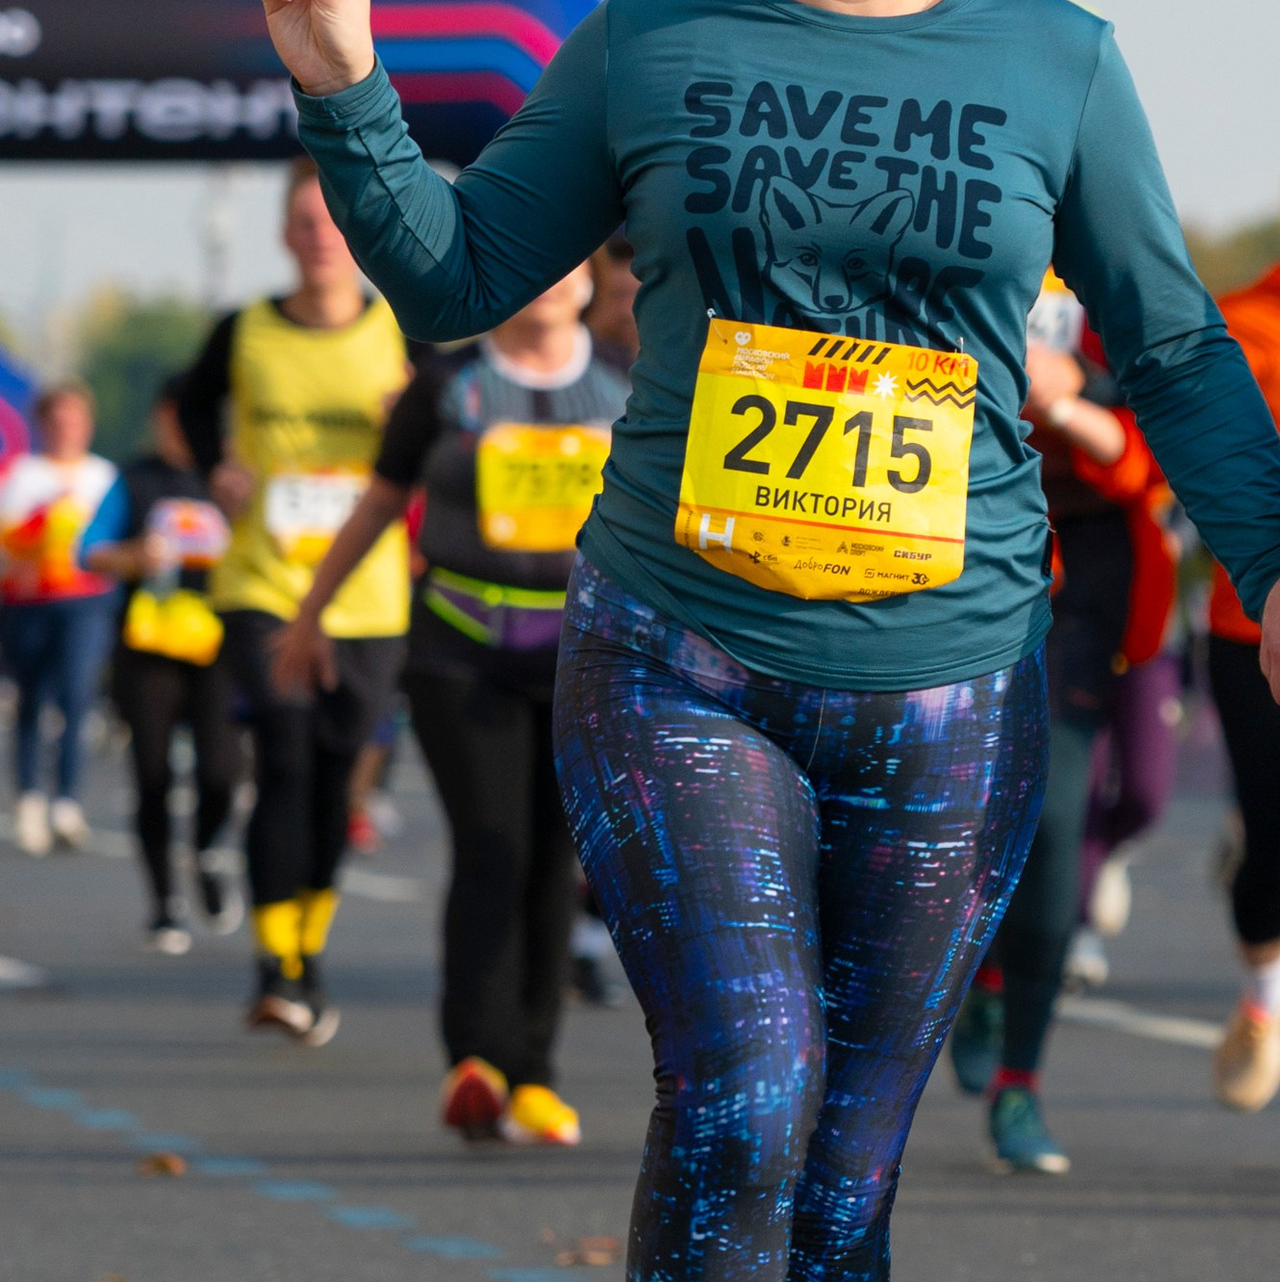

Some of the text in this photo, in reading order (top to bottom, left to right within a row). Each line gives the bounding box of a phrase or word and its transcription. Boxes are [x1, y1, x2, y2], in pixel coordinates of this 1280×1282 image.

[684, 80, 1007, 171] SAVE ME
[684, 144, 1002, 260] SAVE THE
[907, 351, 930, 372] 10
[723, 394, 934, 494] 2715
[755, 485, 892, 523] ВИКТОРИЯ
[893, 549, 932, 561] СИБУР
[877, 571, 910, 581] МАГНИТ
